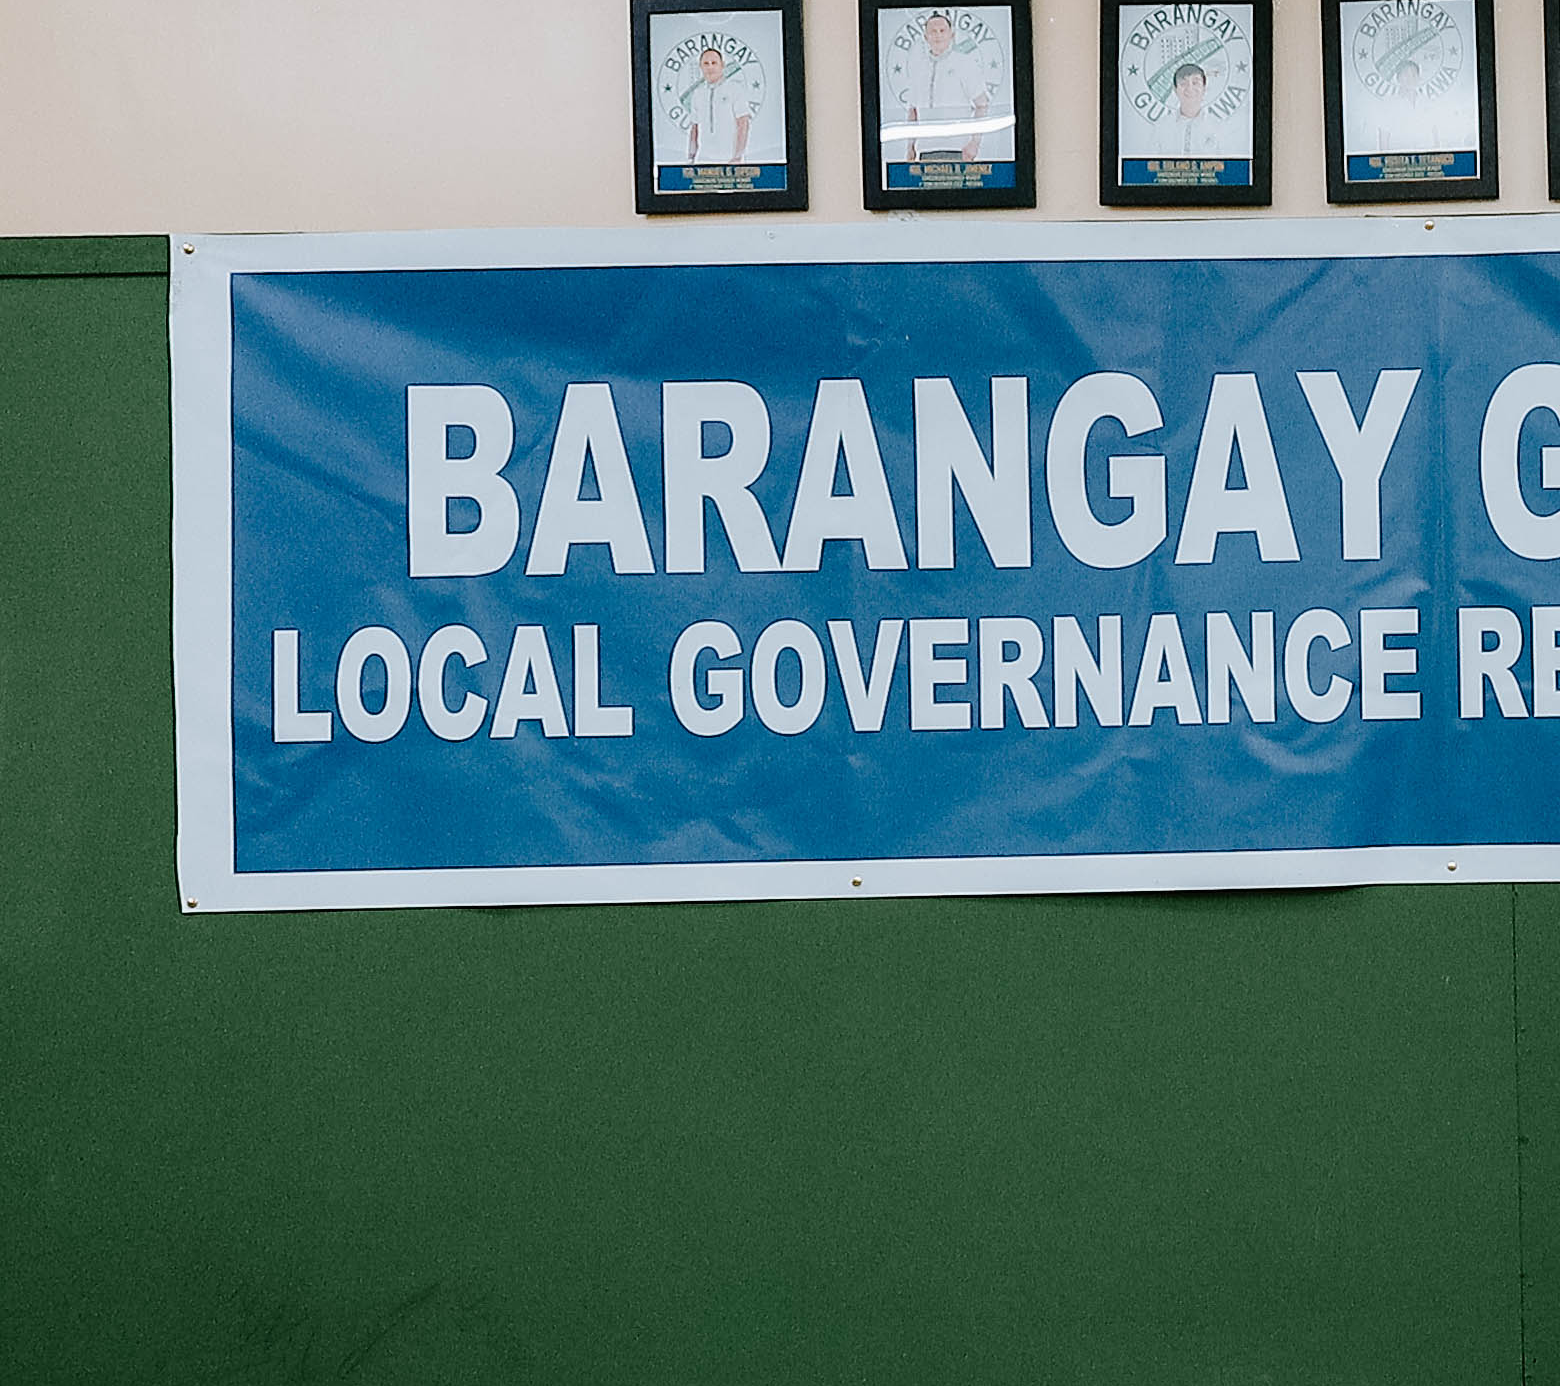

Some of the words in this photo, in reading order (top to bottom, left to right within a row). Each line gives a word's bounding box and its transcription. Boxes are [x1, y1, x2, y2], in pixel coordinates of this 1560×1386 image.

[1130, 4, 1243, 50] BARANGAY
[1360, 0, 1455, 37] BARANGAY
[665, 33, 758, 72] BARANGAY
[407, 368, 1422, 579] BARANGAY
[272, 623, 635, 745] LOCAL
[669, 607, 1422, 738] GOVERNANCE
